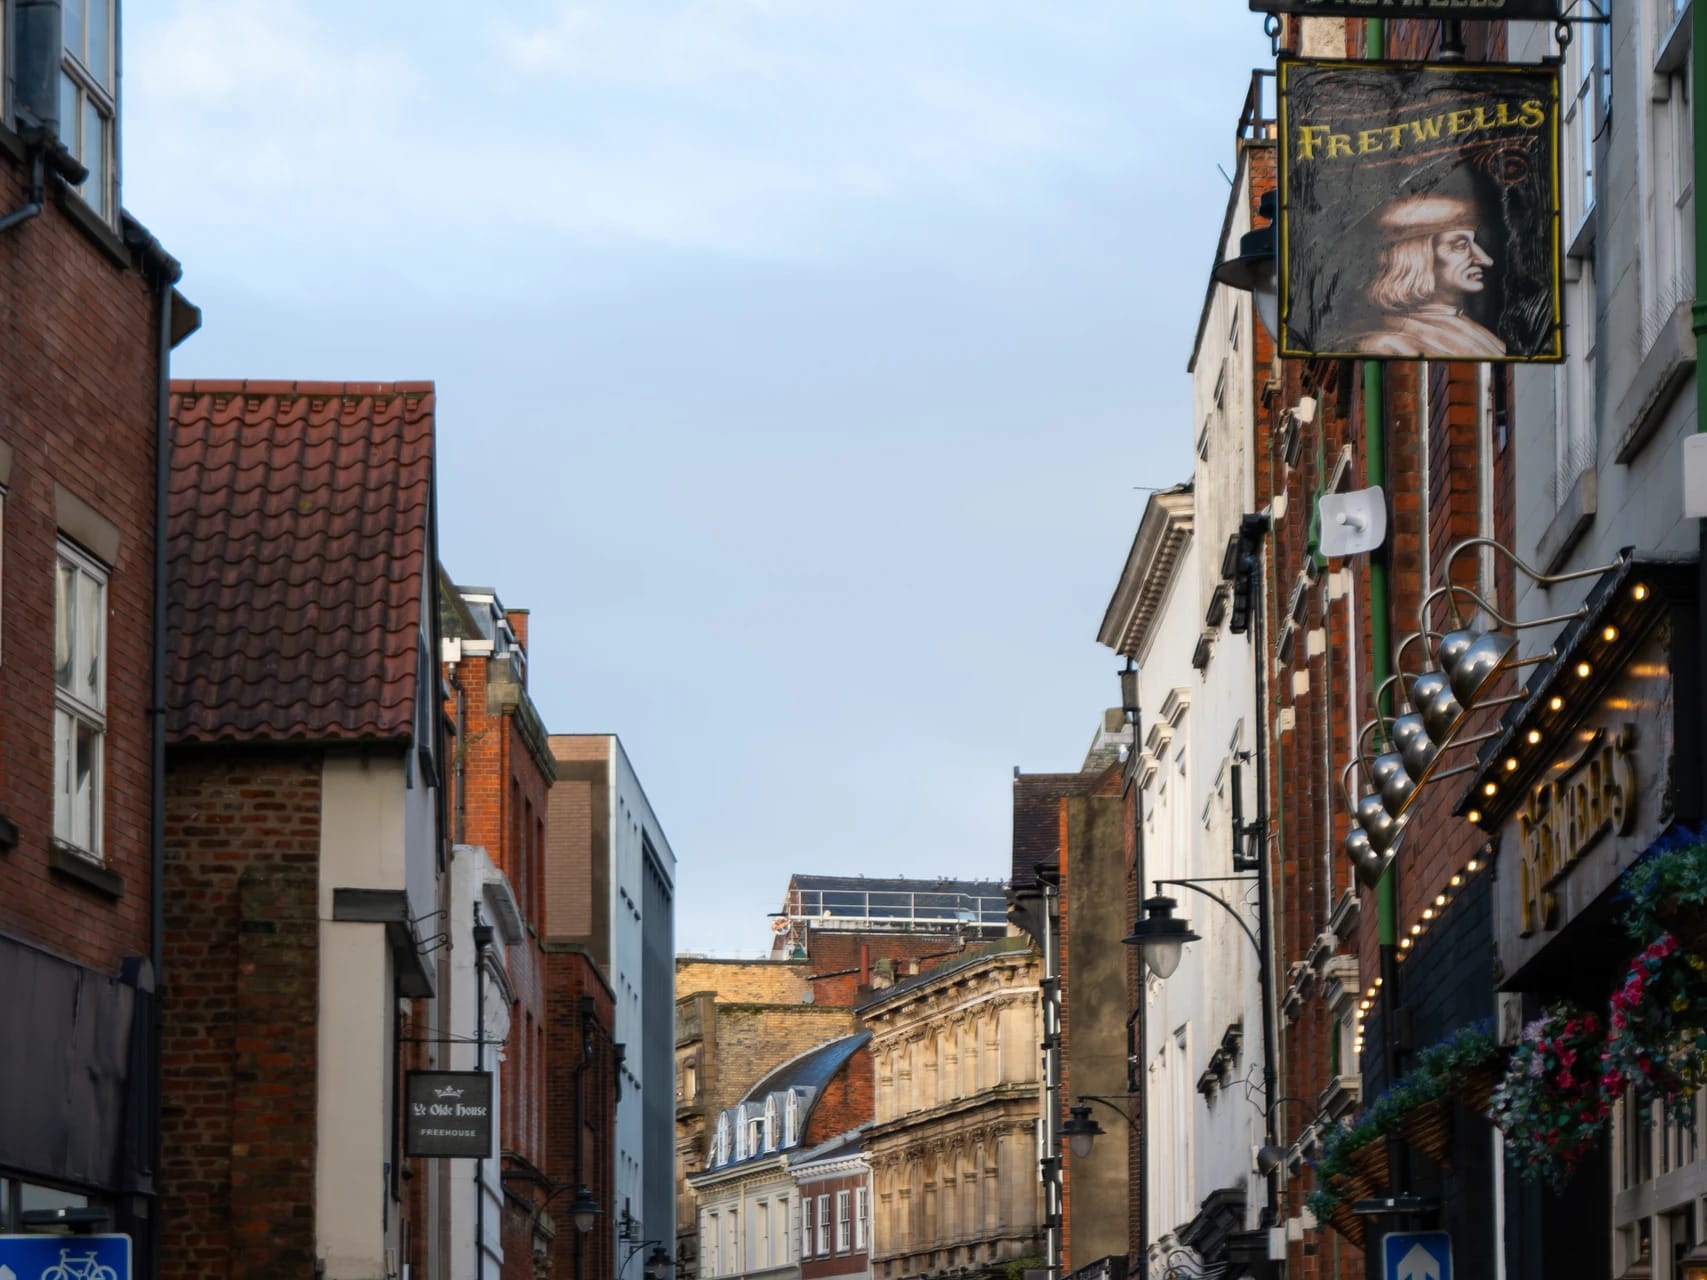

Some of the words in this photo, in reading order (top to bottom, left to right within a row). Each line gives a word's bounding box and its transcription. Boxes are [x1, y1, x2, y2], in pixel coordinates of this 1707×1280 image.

[1297, 99, 1545, 161] FRETWELLS
[430, 1103, 452, 1116] Olde
[420, 1129, 477, 1137] FREEHOUSE
